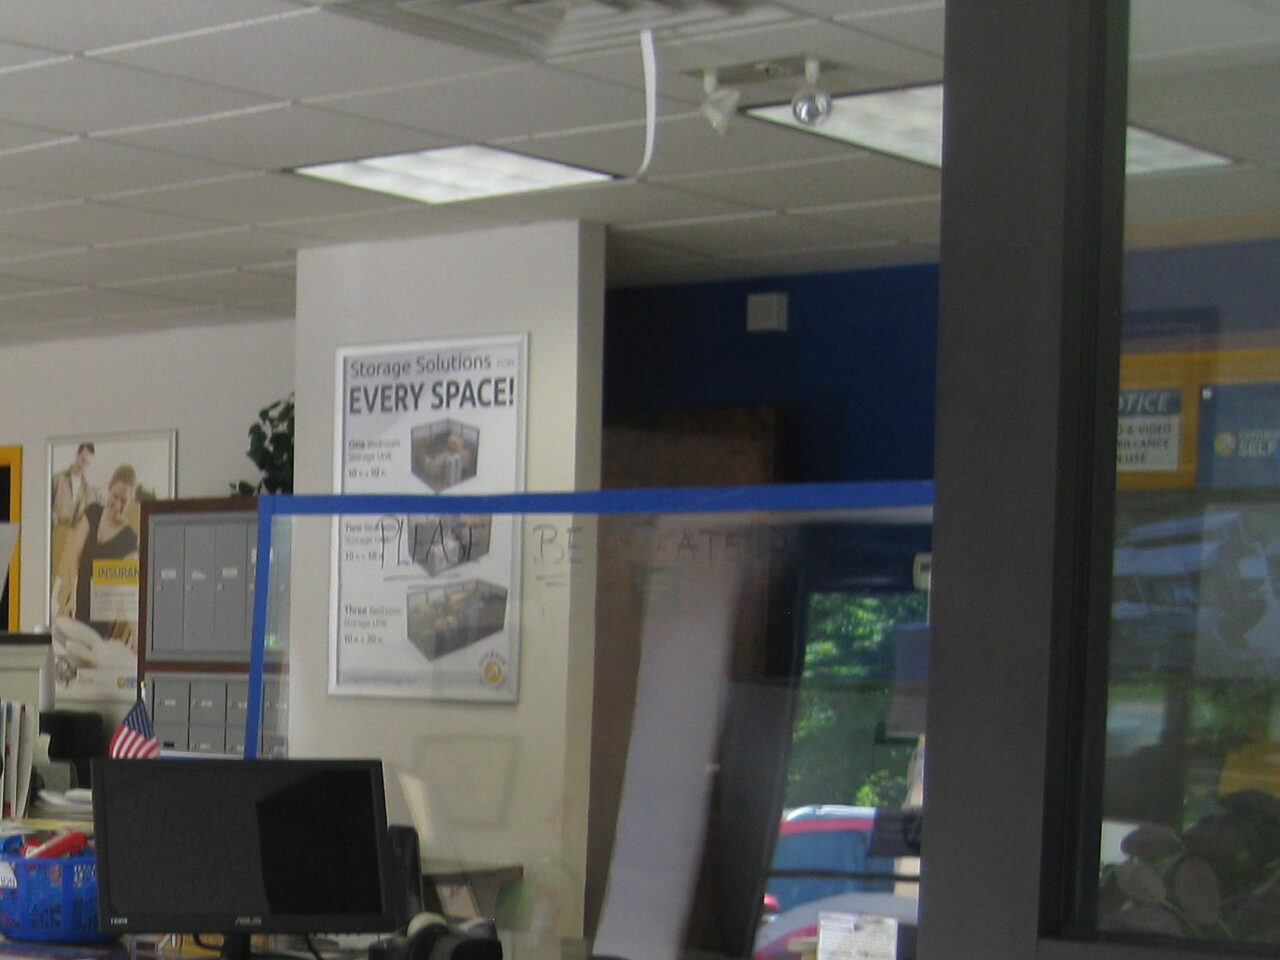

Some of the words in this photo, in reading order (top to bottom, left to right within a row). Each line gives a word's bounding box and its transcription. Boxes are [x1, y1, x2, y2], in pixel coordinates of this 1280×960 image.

[350, 360, 411, 380] Storage
[416, 353, 492, 374] Solutions
[349, 382, 425, 414] EVERY
[431, 377, 515, 410] SPACE!
